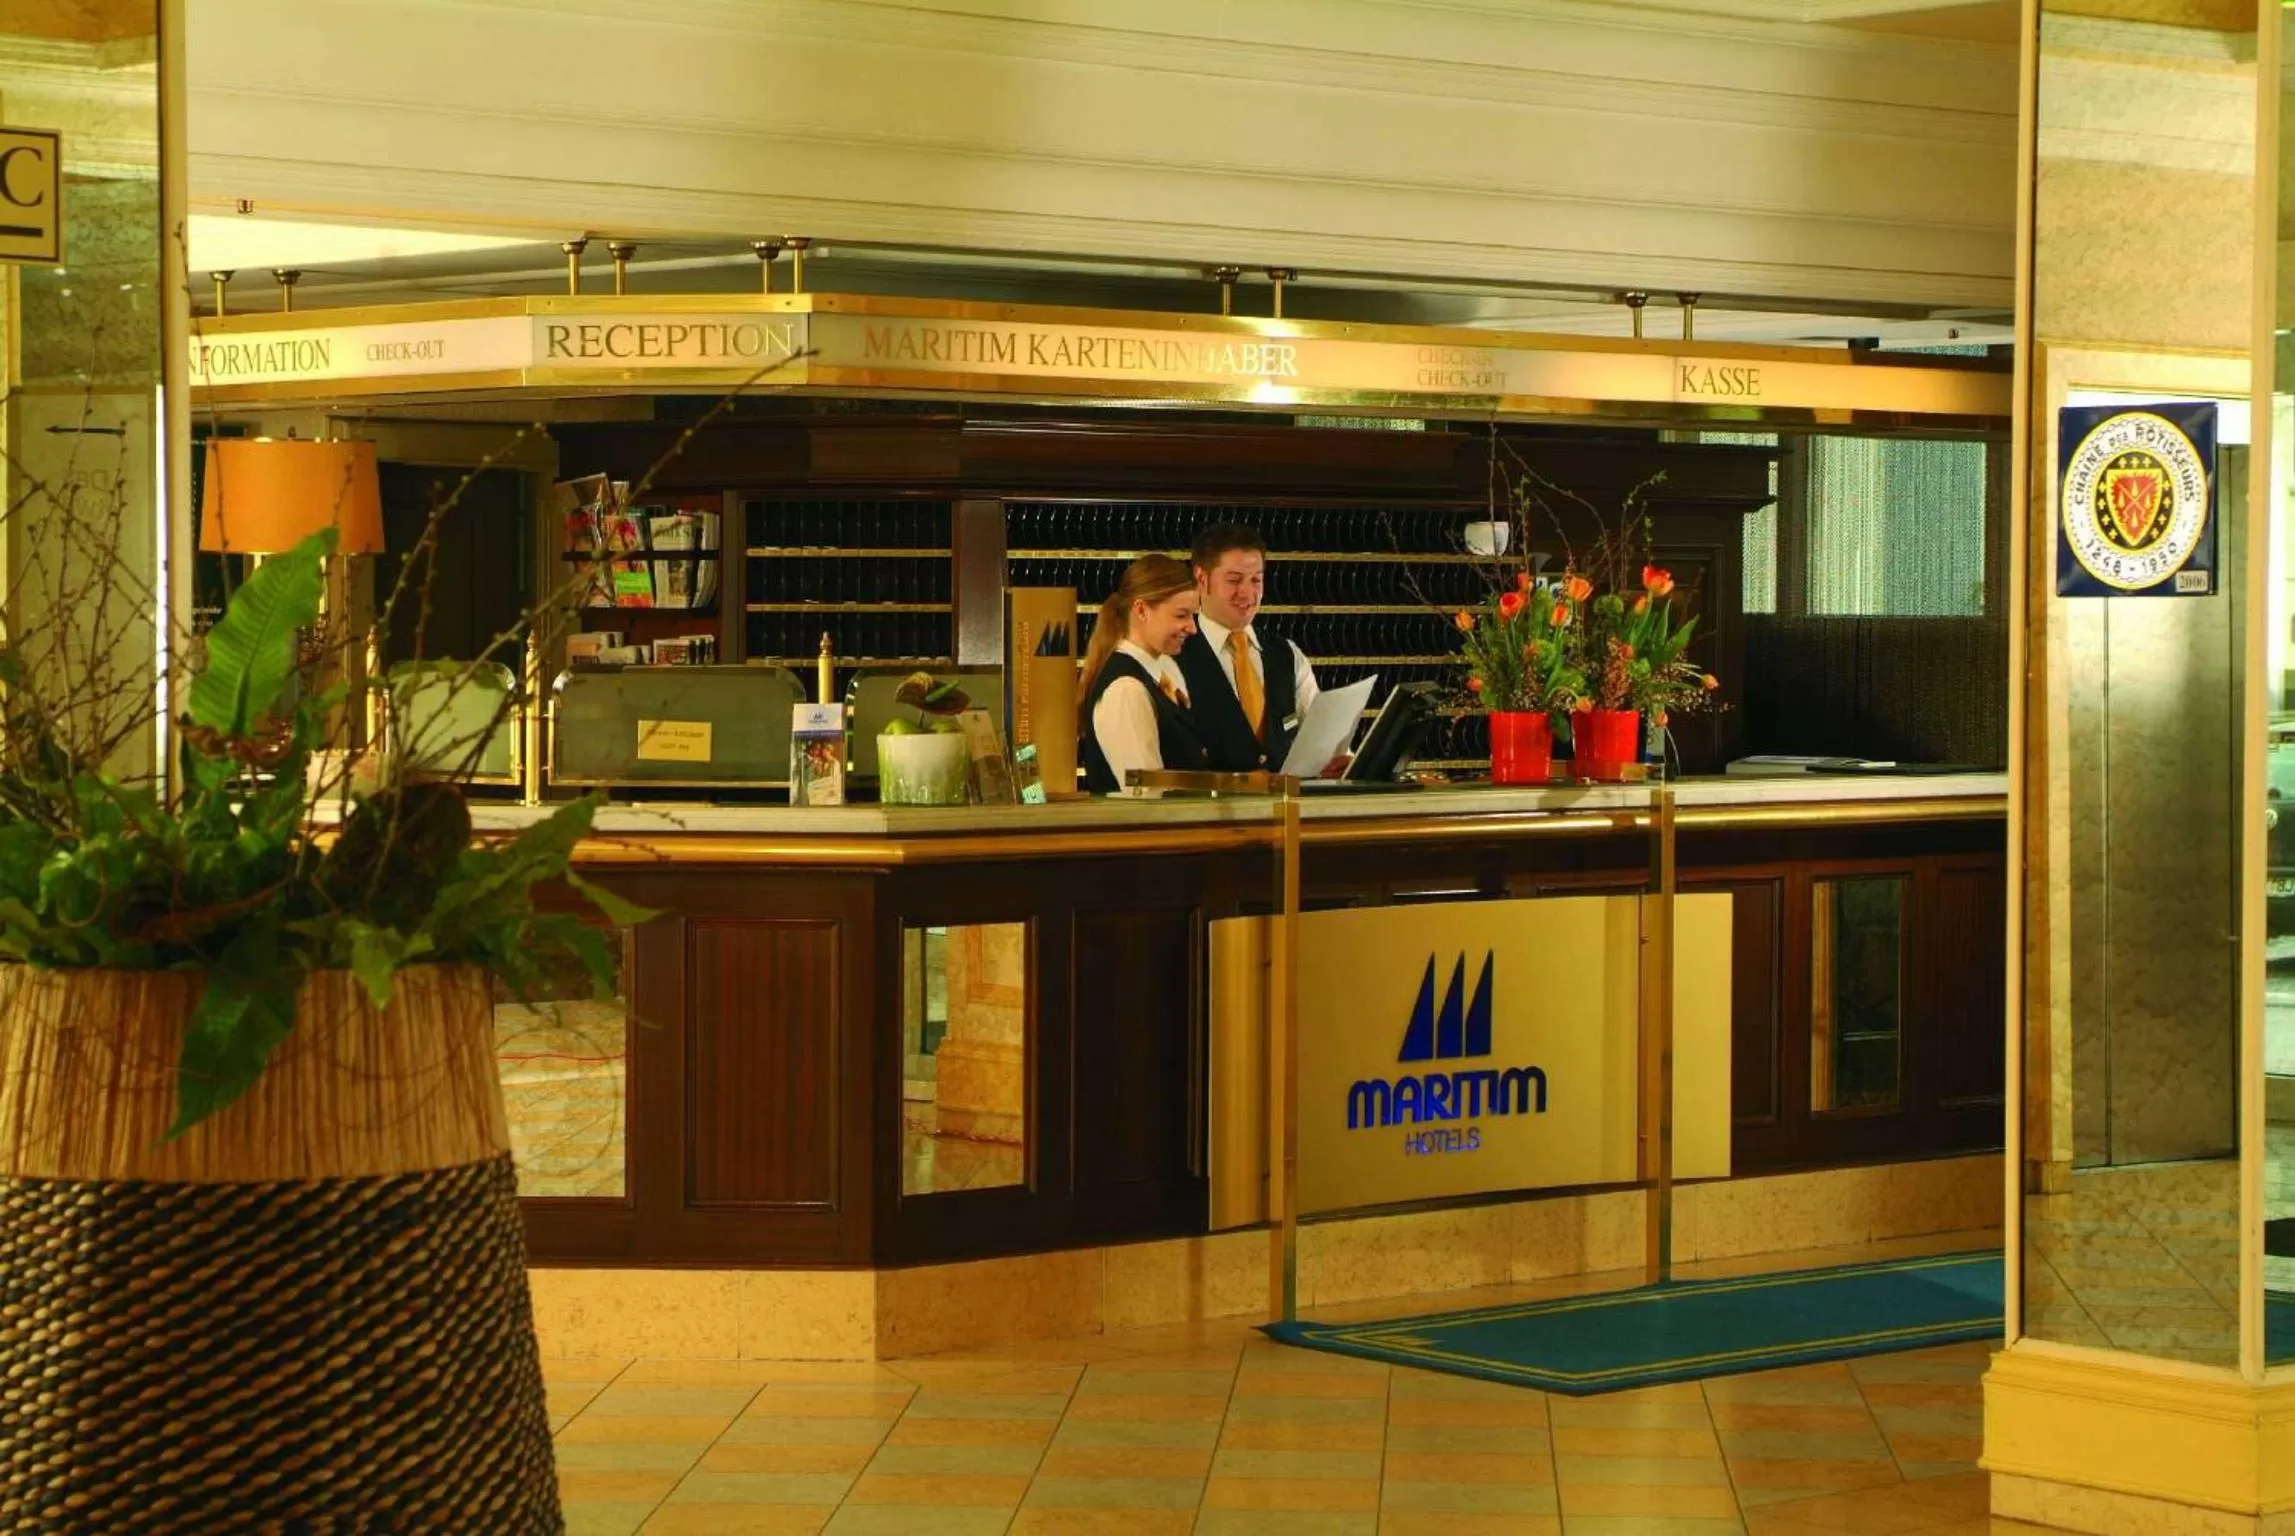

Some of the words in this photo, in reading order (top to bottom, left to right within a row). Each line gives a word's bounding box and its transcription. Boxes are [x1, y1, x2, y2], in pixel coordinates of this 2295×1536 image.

[366, 339, 445, 361] CHECK-OUT
[547, 323, 794, 358] RECEPTION
[862, 325, 1016, 364] MARITIM
[1028, 333, 1298, 378] KARTENINHABER
[1418, 369, 1507, 389] CHECK-OUT
[1680, 363, 1762, 397] KASSE
[1405, 1126, 1481, 1157] HOTELS
